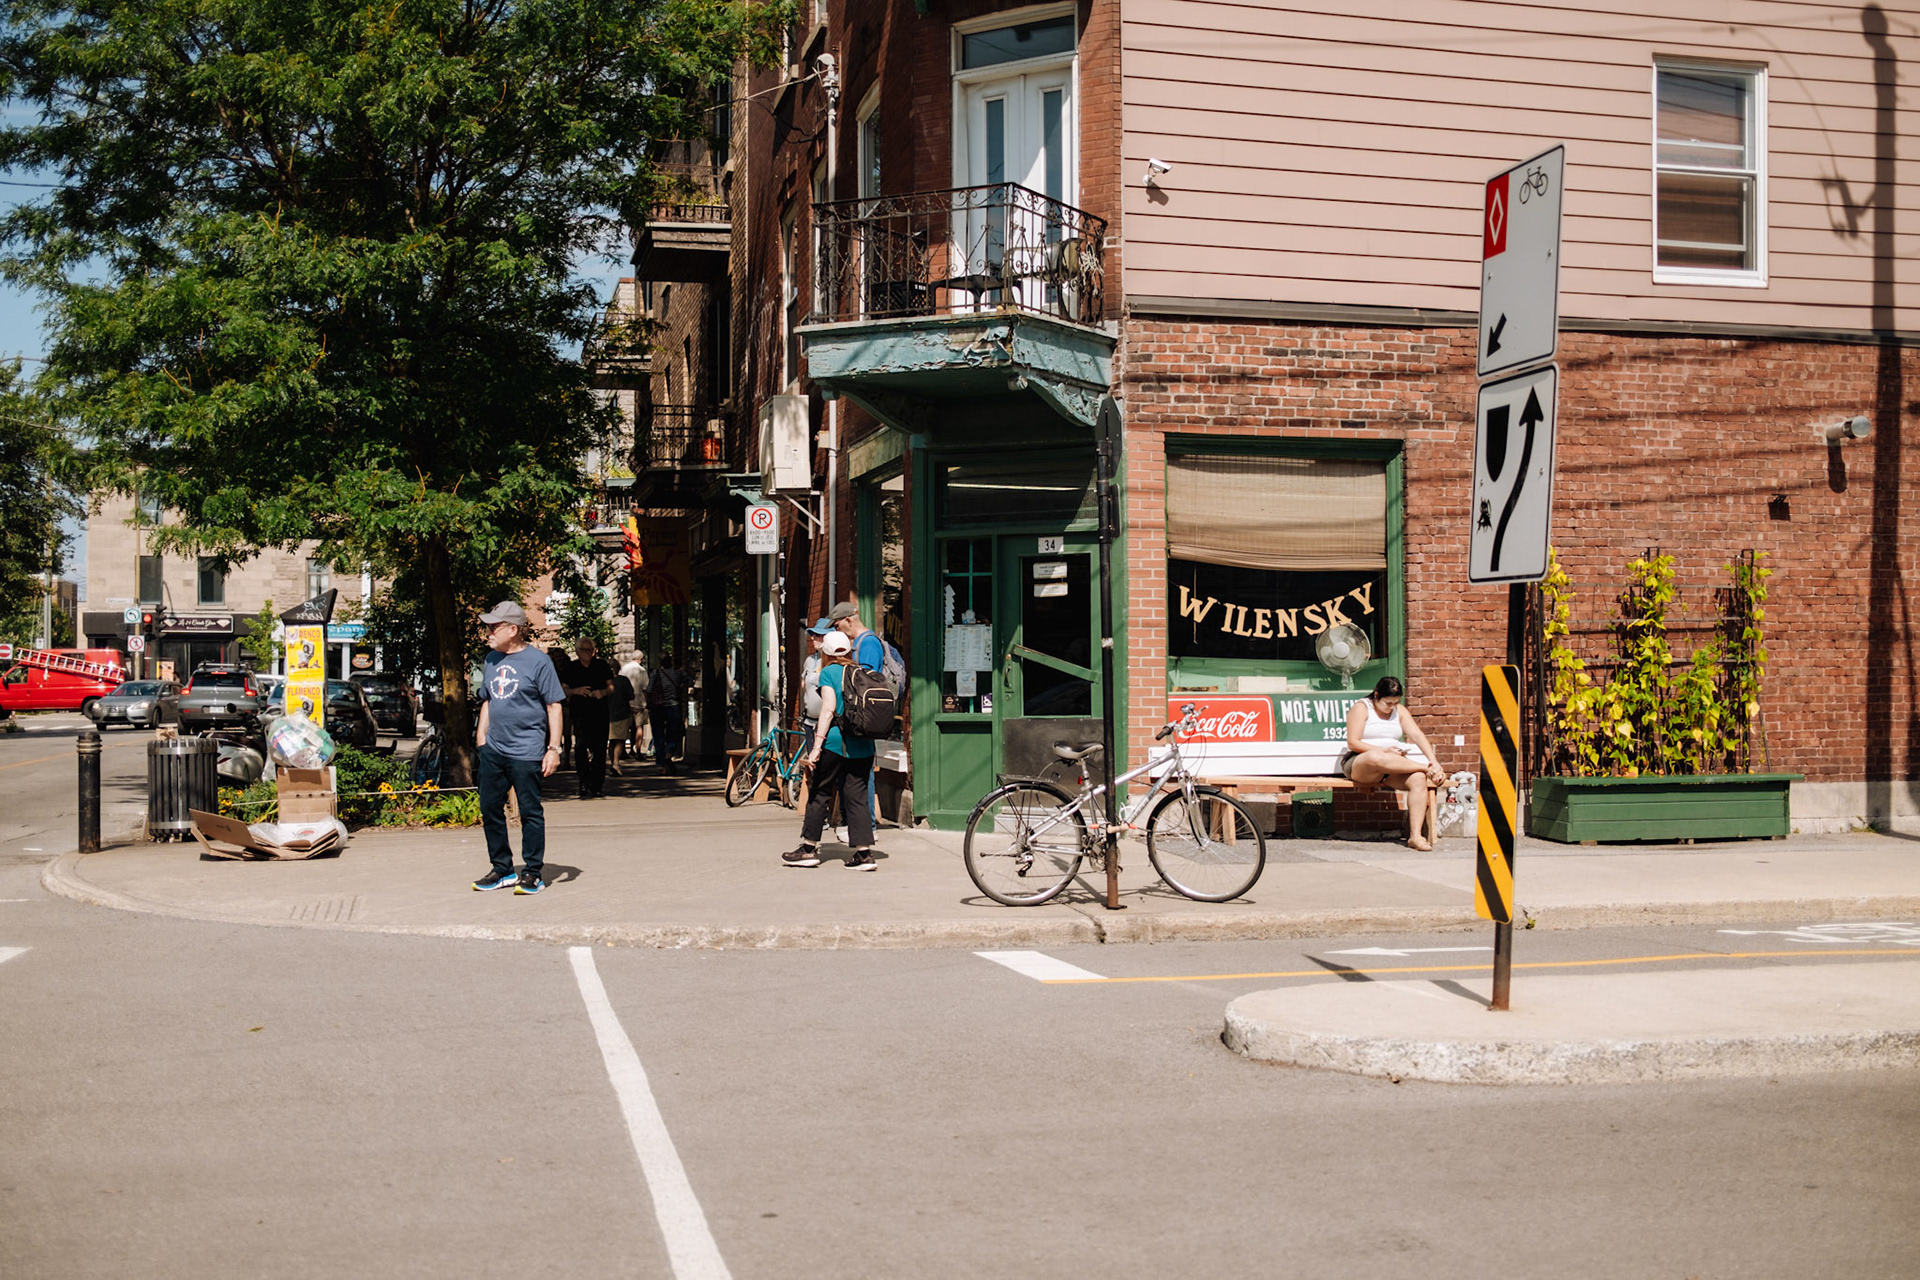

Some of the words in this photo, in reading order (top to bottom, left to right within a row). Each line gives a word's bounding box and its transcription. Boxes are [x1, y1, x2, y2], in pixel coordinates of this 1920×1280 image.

[1044, 539, 1056, 551] 34
[1179, 582, 1375, 639] WILENSKY
[287, 686, 321, 696] FLAMENCO
[1280, 700, 1313, 723] MOE
[1323, 727, 1347, 739] 1932
